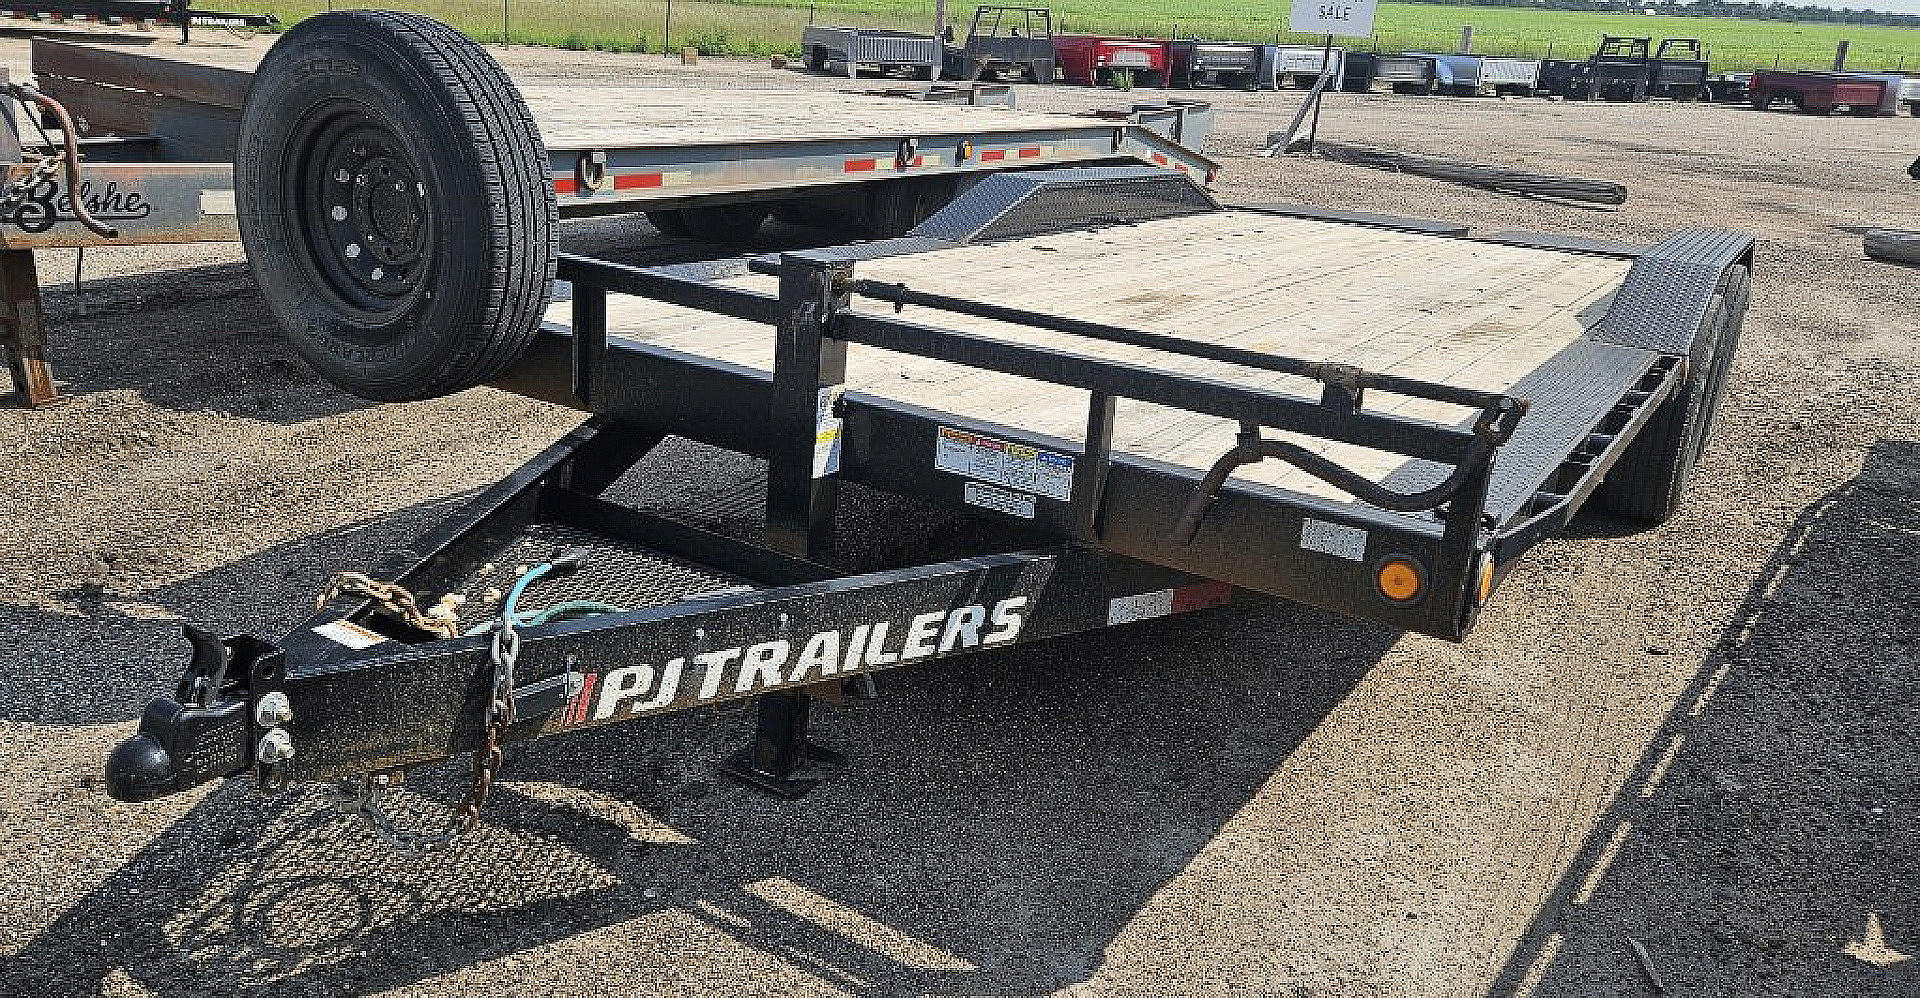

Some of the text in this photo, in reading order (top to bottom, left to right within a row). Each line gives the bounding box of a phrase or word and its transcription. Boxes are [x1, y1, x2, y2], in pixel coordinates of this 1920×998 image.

[1319, 5, 1352, 21] SALE
[596, 596, 1028, 720] PJ TRAILERS
